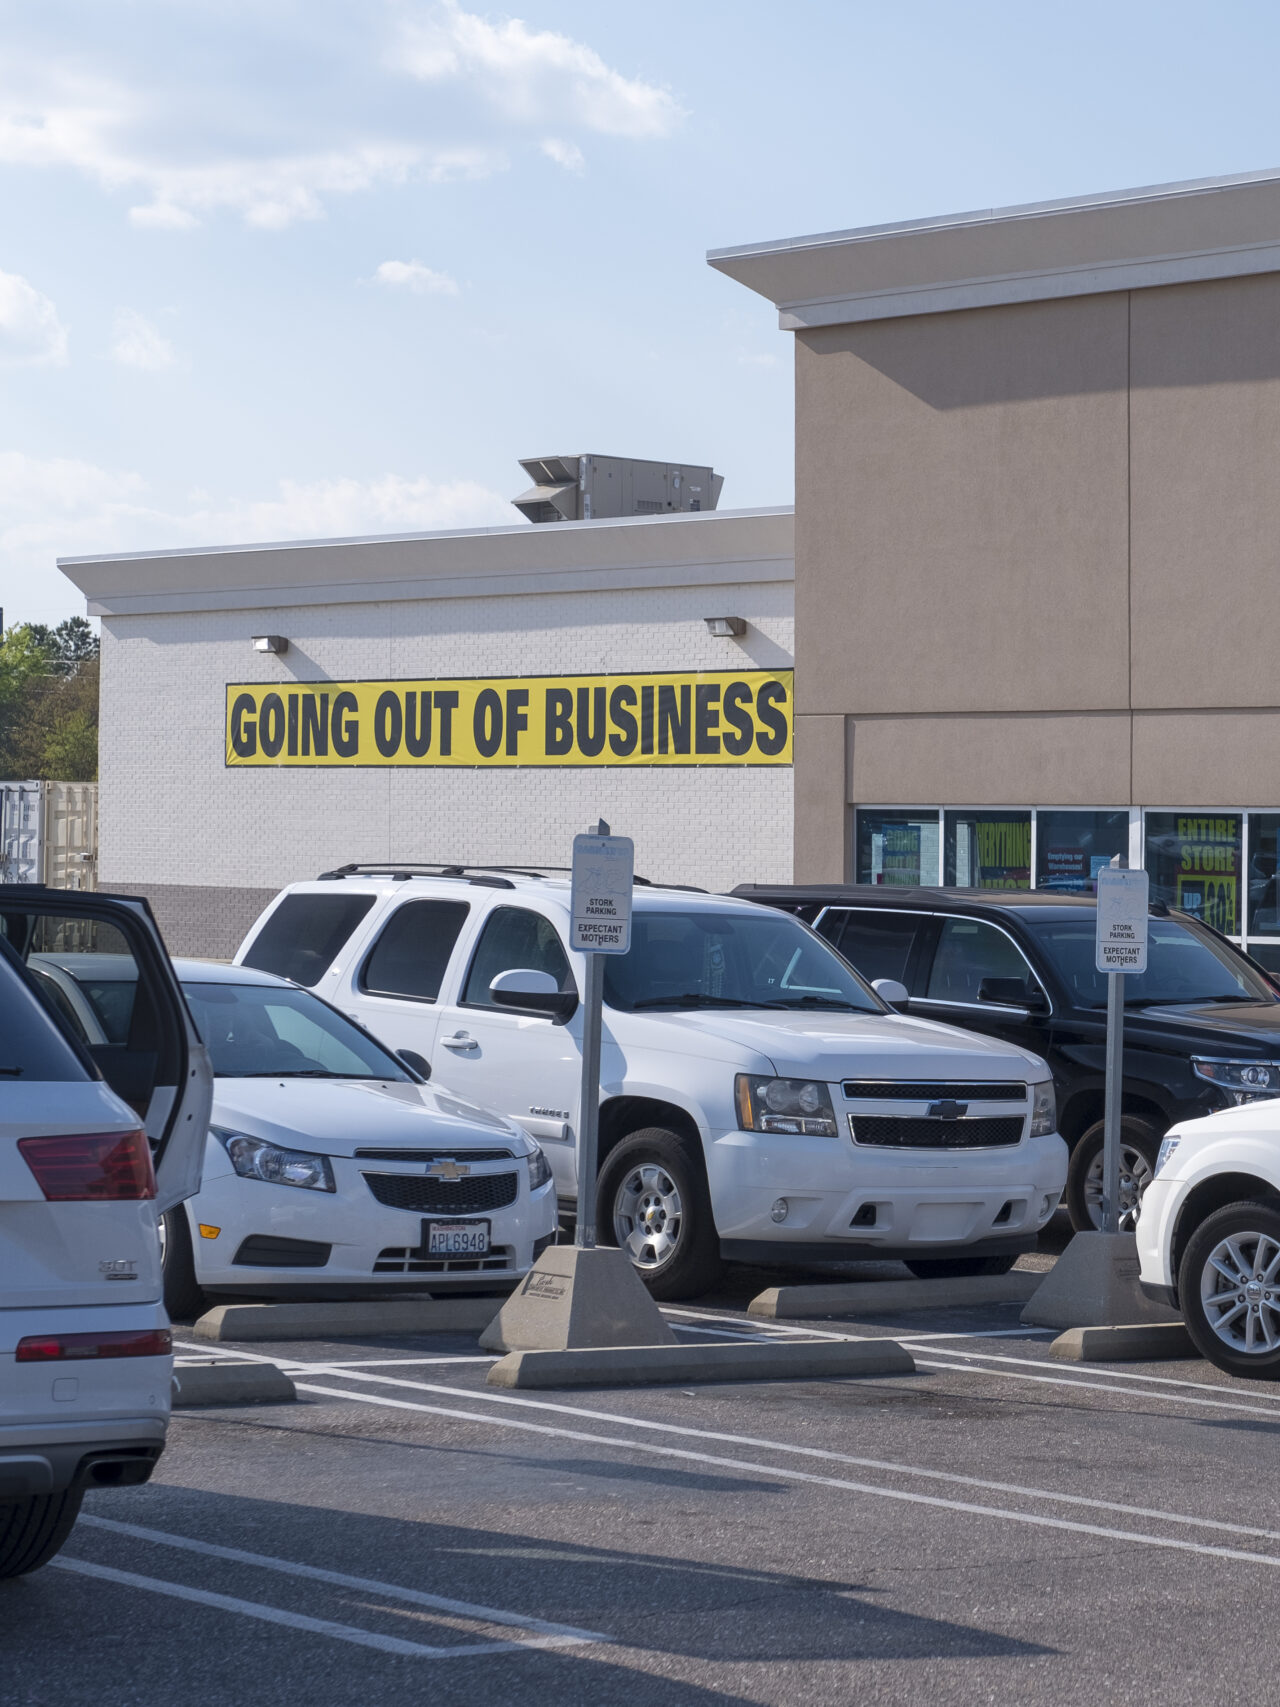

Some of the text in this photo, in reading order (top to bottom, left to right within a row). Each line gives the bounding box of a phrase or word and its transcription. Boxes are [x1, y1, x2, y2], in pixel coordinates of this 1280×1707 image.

[231, 680, 788, 758] GOING OUT OF BUSINESS
[1178, 818, 1236, 842] ENTIRE
[976, 822, 1031, 868] VERYTHING
[1181, 845, 1235, 871] STORE
[1184, 893, 1201, 909] UP
[586, 907, 616, 915] PARKING
[578, 924, 623, 934] EXPECTANT
[581, 934, 619, 943] MOTHERS
[1104, 947, 1140, 955] EXPECTANT
[431, 1233, 485, 1251] APL6948
